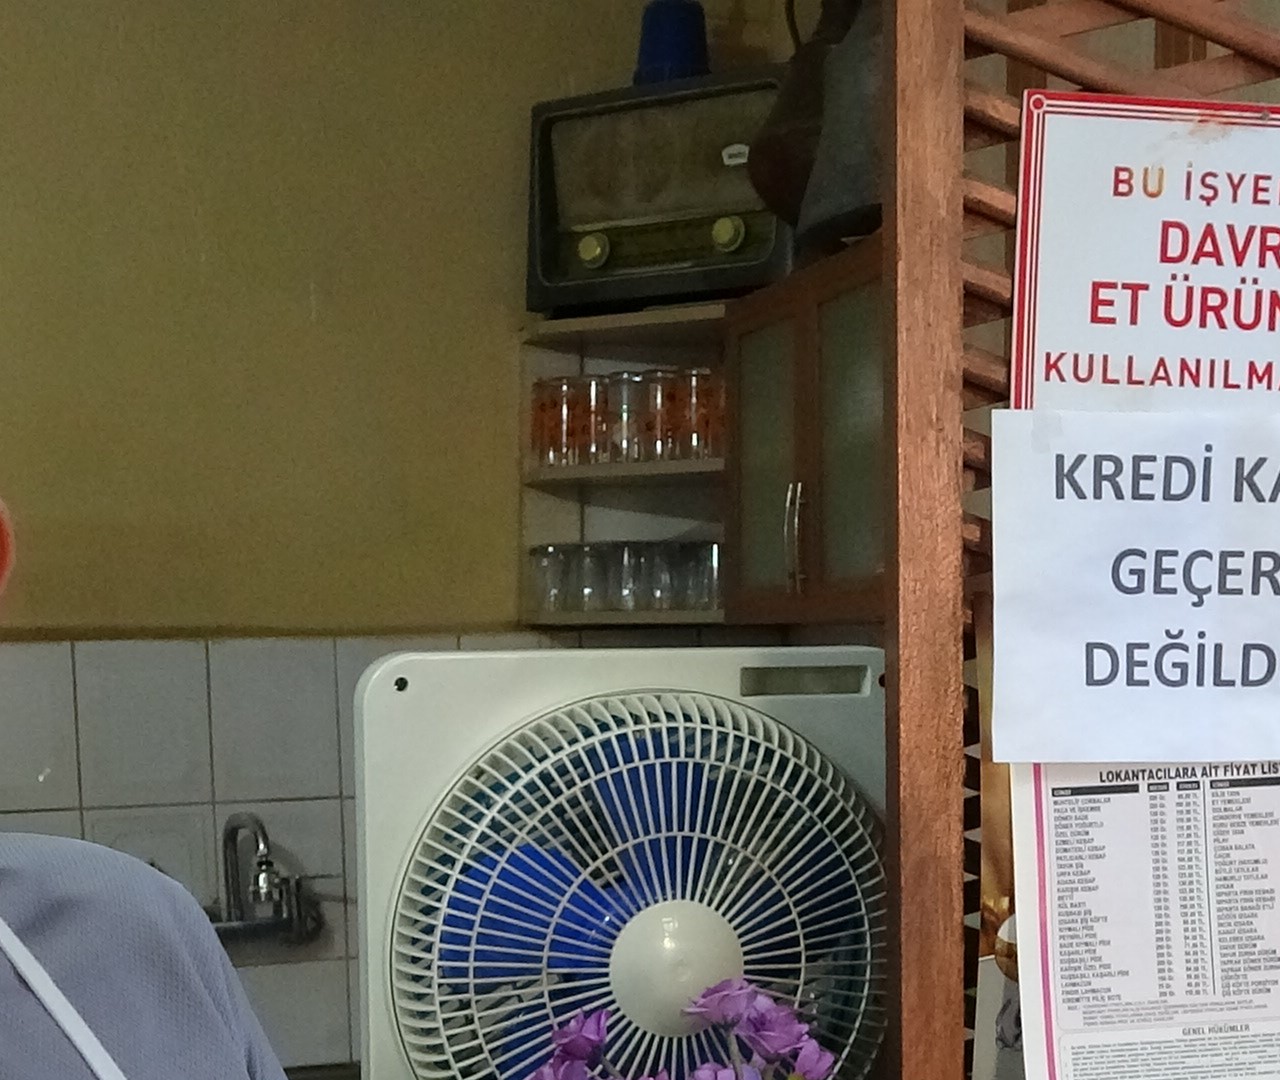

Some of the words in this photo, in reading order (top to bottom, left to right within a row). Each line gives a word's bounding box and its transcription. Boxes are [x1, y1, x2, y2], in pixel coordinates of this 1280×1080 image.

[1113, 163, 1165, 197] BU
[1091, 282, 1149, 325] ET
[1056, 444, 1212, 502] KREDİ
[1099, 766, 1197, 783] LOKANTACILARA
[1201, 763, 1220, 778] AİT
[1223, 762, 1257, 777] FİYAT
